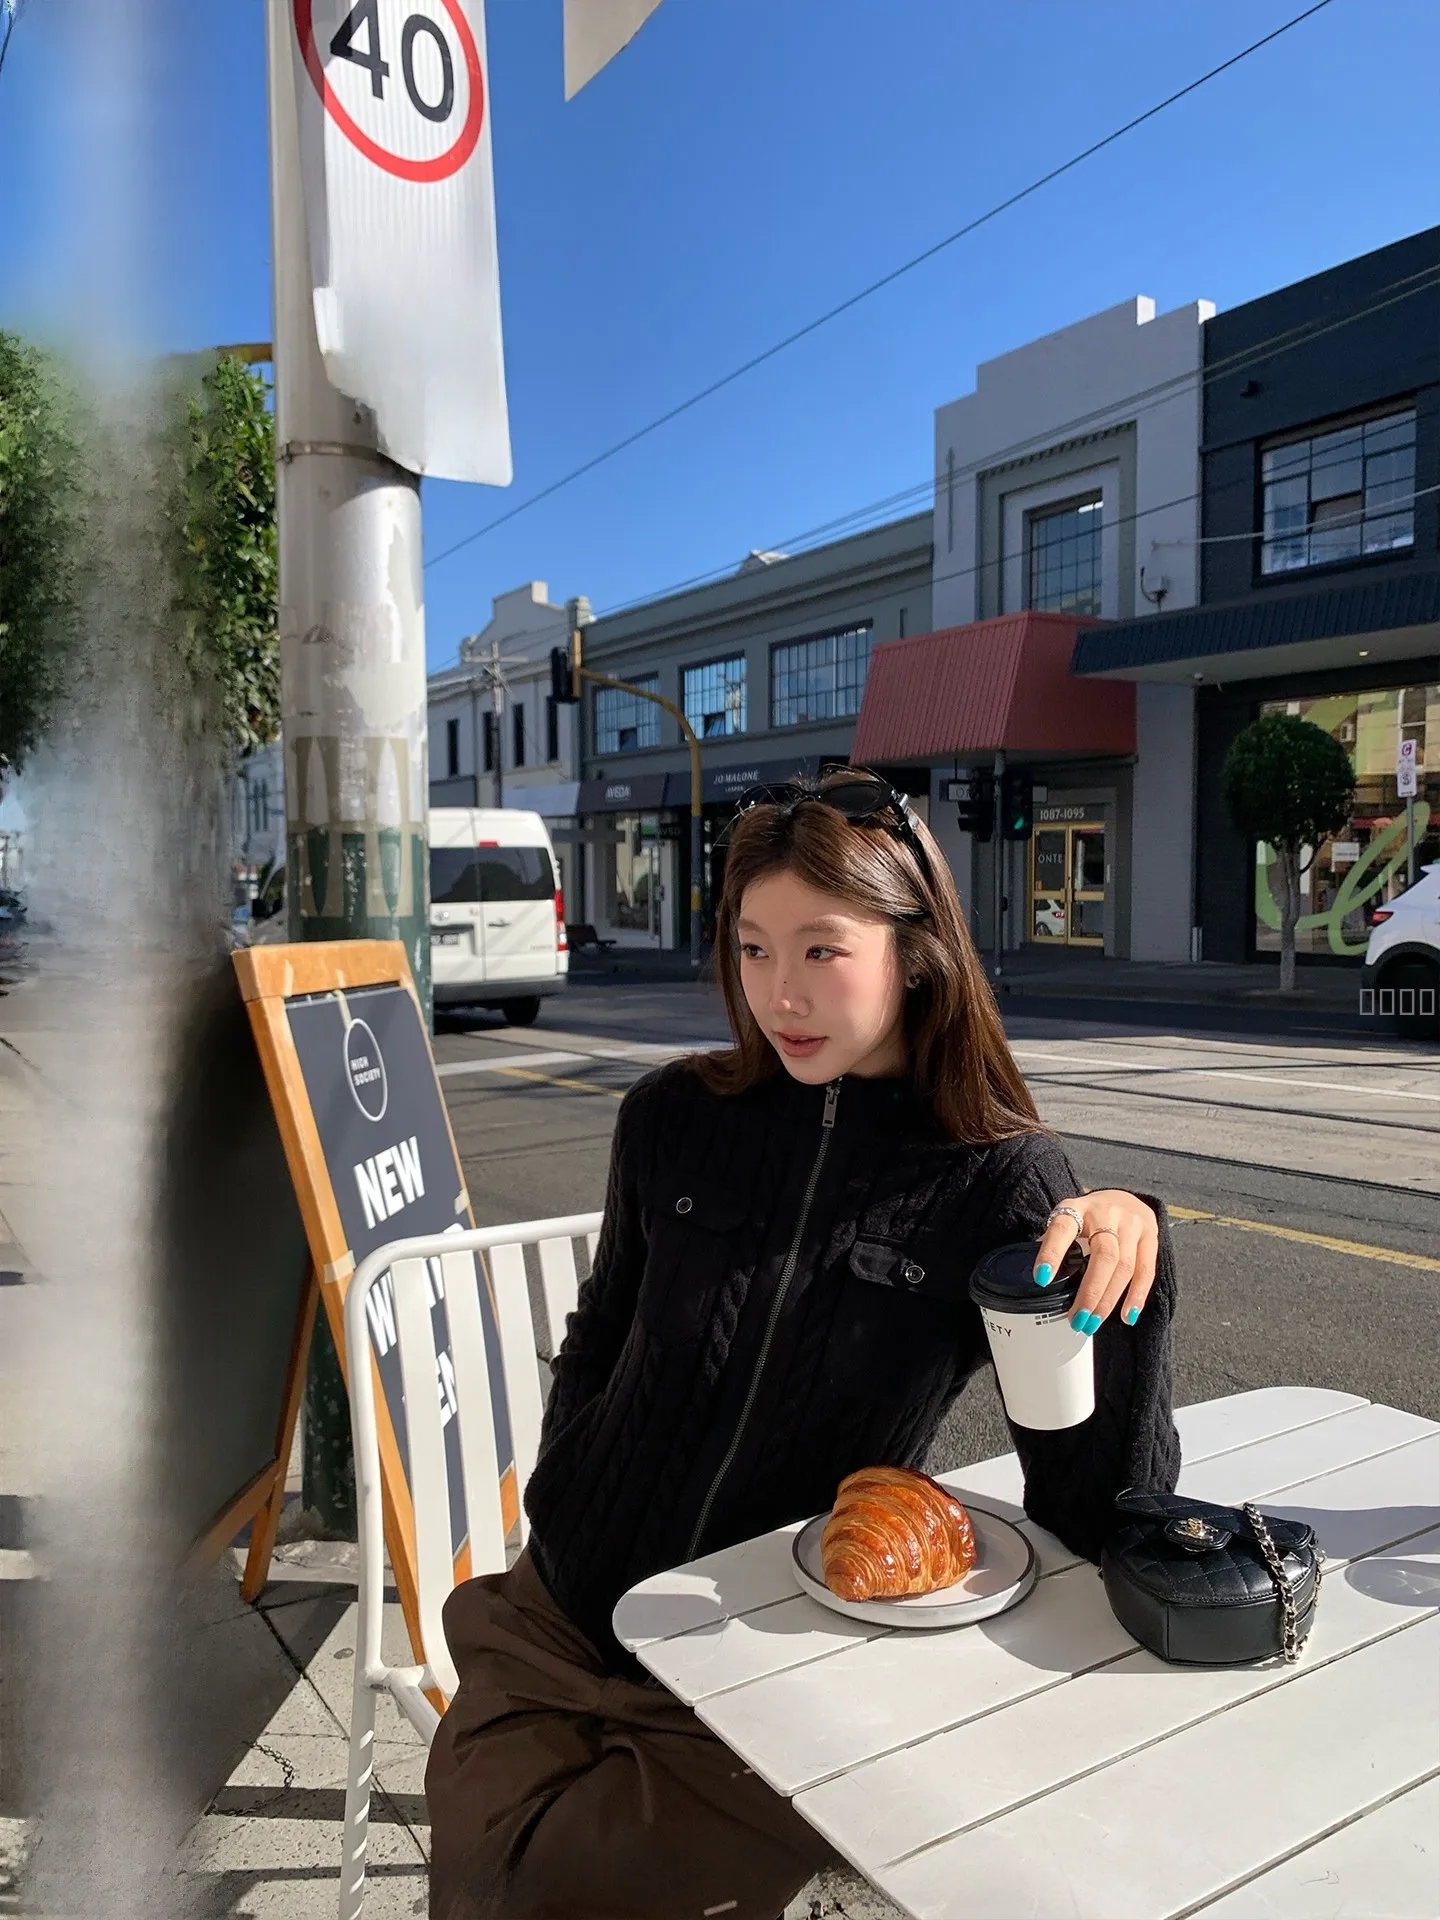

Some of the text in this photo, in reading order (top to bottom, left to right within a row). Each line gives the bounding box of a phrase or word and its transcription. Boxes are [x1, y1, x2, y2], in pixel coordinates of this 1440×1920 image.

[329, 0, 455, 123] 40
[725, 770, 760, 783] MALONE
[1040, 807, 1085, 820] 1087-1095
[350, 1056, 369, 1071] HIGH
[353, 1067, 381, 1087] SOCIETY
[353, 1135, 426, 1230] NEW
[985, 1319, 1012, 1337] IETY
